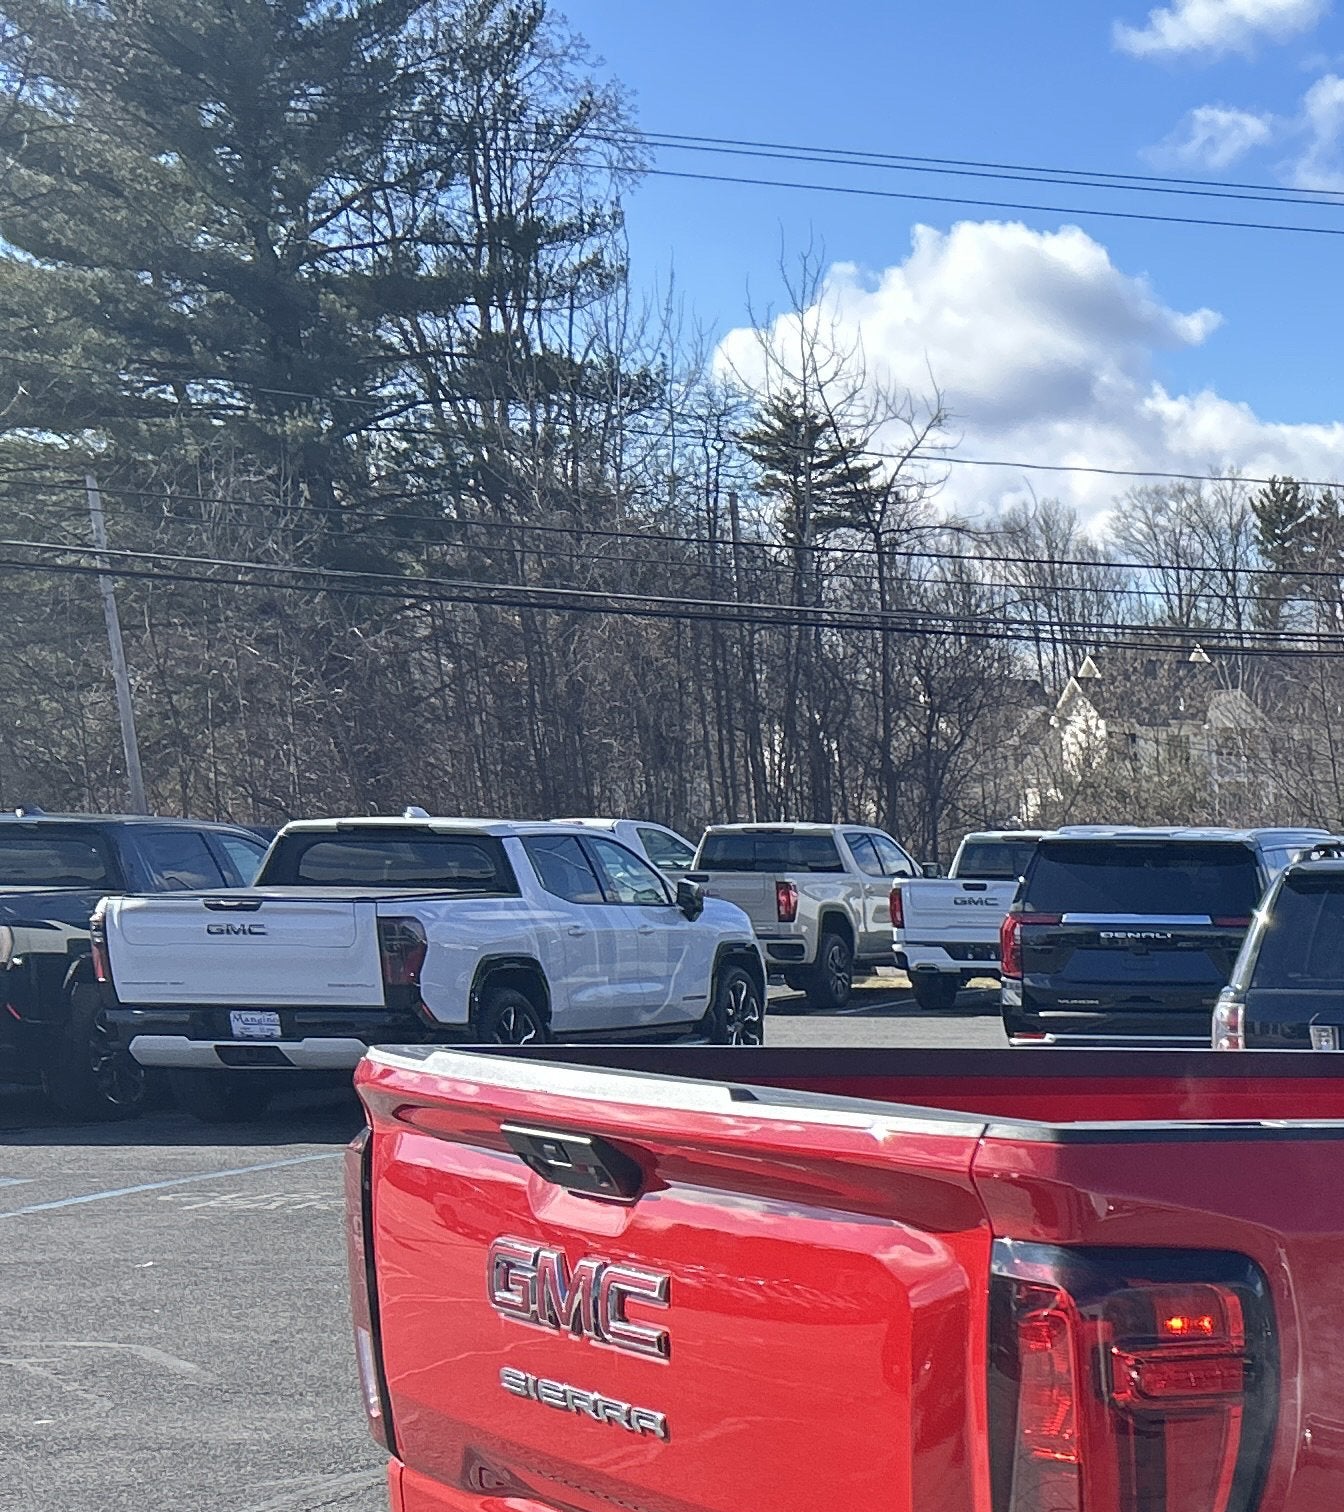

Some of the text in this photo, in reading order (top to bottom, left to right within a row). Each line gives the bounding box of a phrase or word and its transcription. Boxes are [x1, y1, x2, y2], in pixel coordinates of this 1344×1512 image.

[954, 897, 999, 906] GMC
[206, 924, 268, 936] GMC
[487, 1236, 671, 1362] GMC
[499, 1366, 671, 1443] SIERRA
